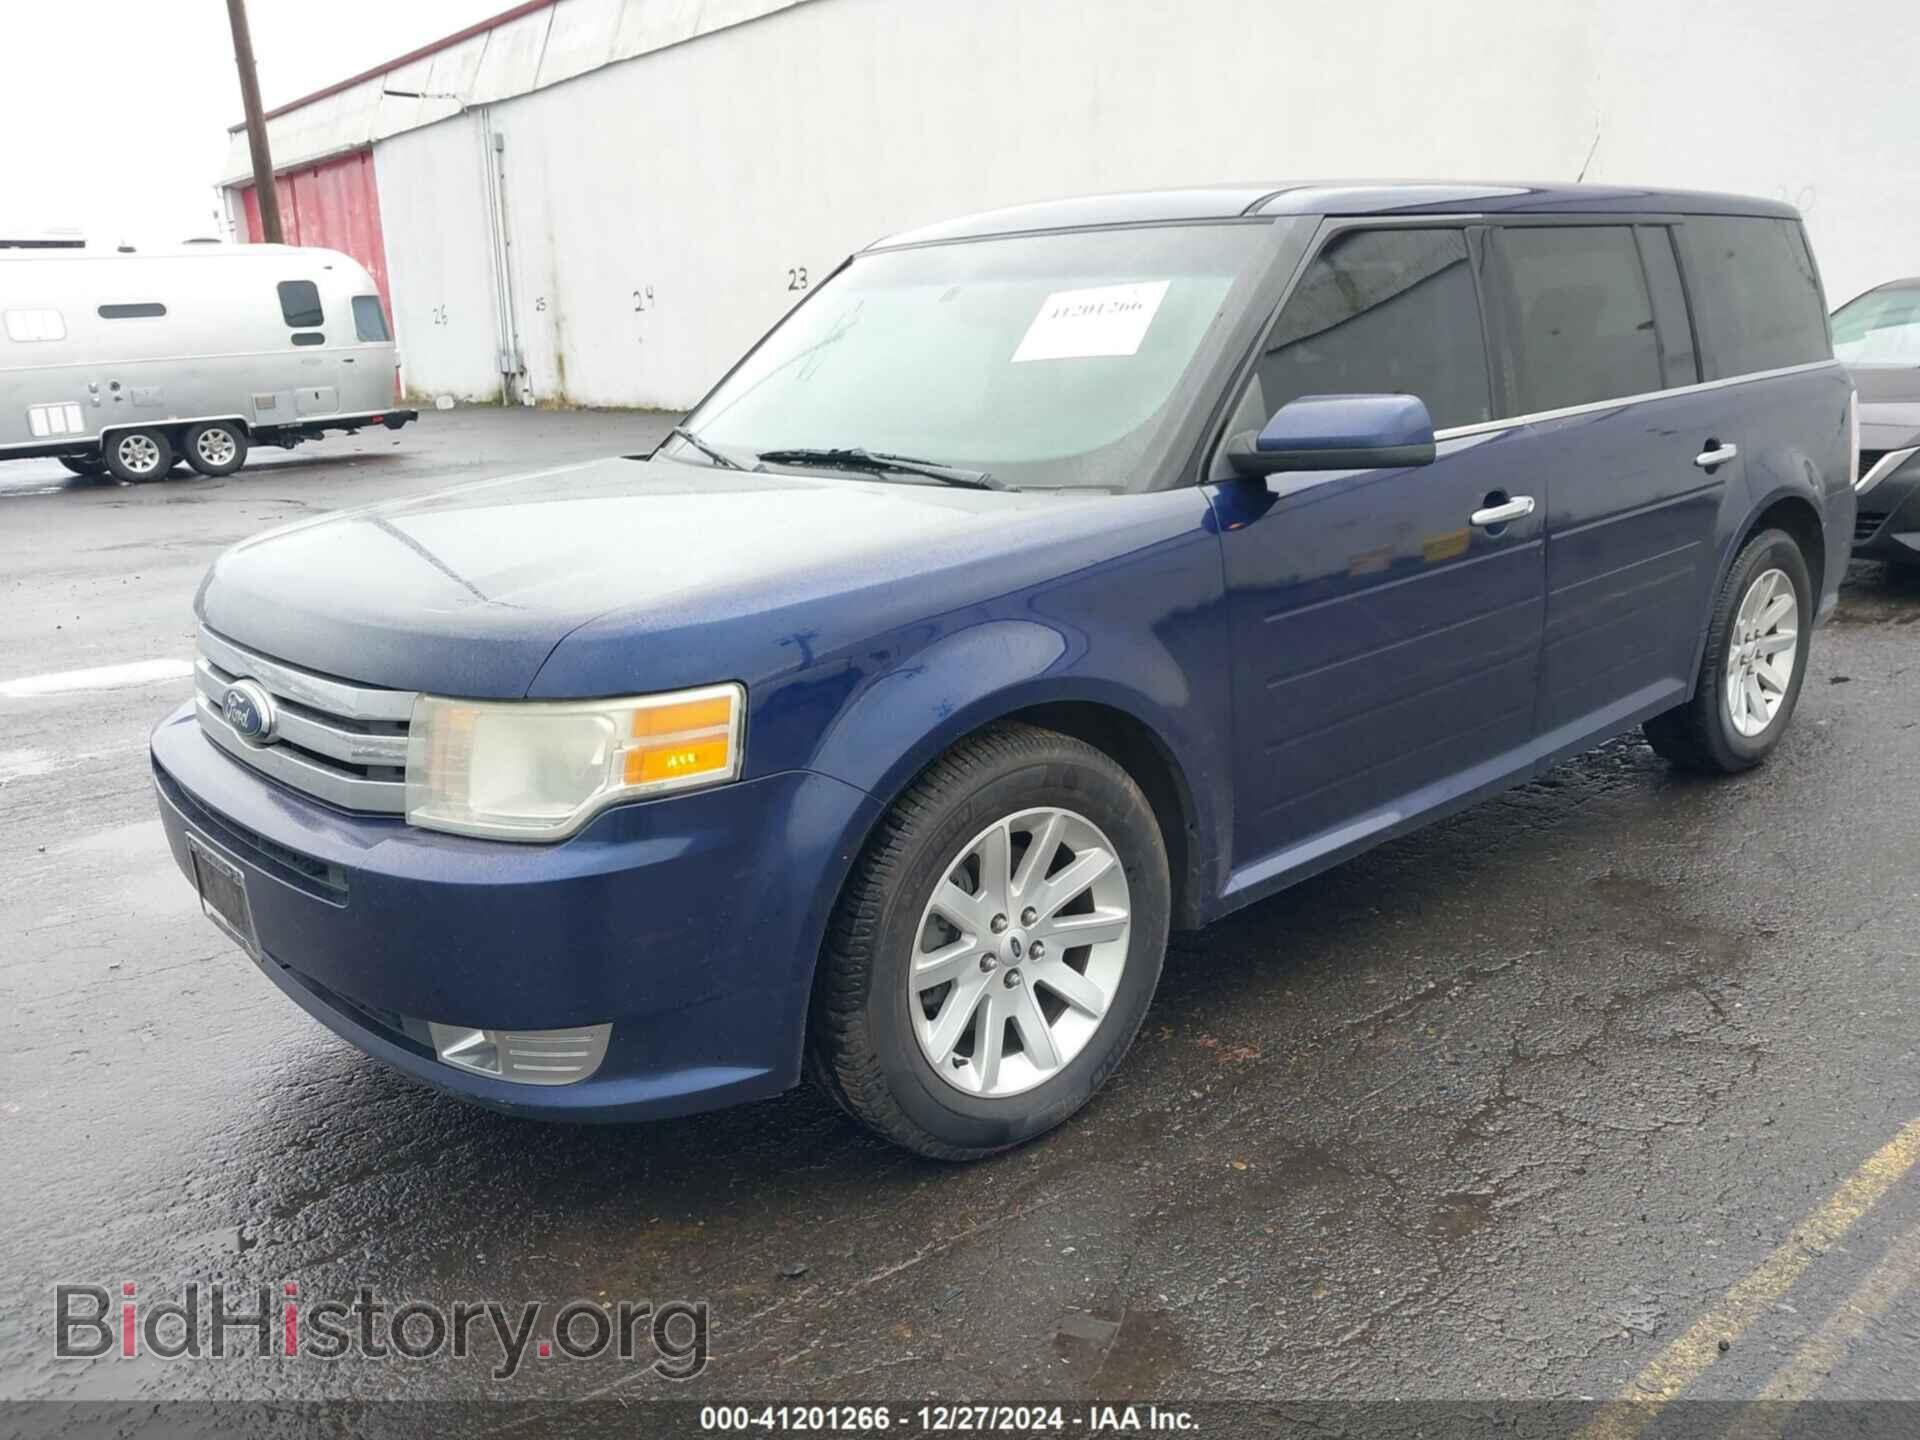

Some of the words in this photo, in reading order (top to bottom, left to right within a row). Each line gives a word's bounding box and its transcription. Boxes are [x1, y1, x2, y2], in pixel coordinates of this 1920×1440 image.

[788, 267, 809, 291] 23
[633, 286, 655, 312] 24
[223, 691, 250, 729] Ford
